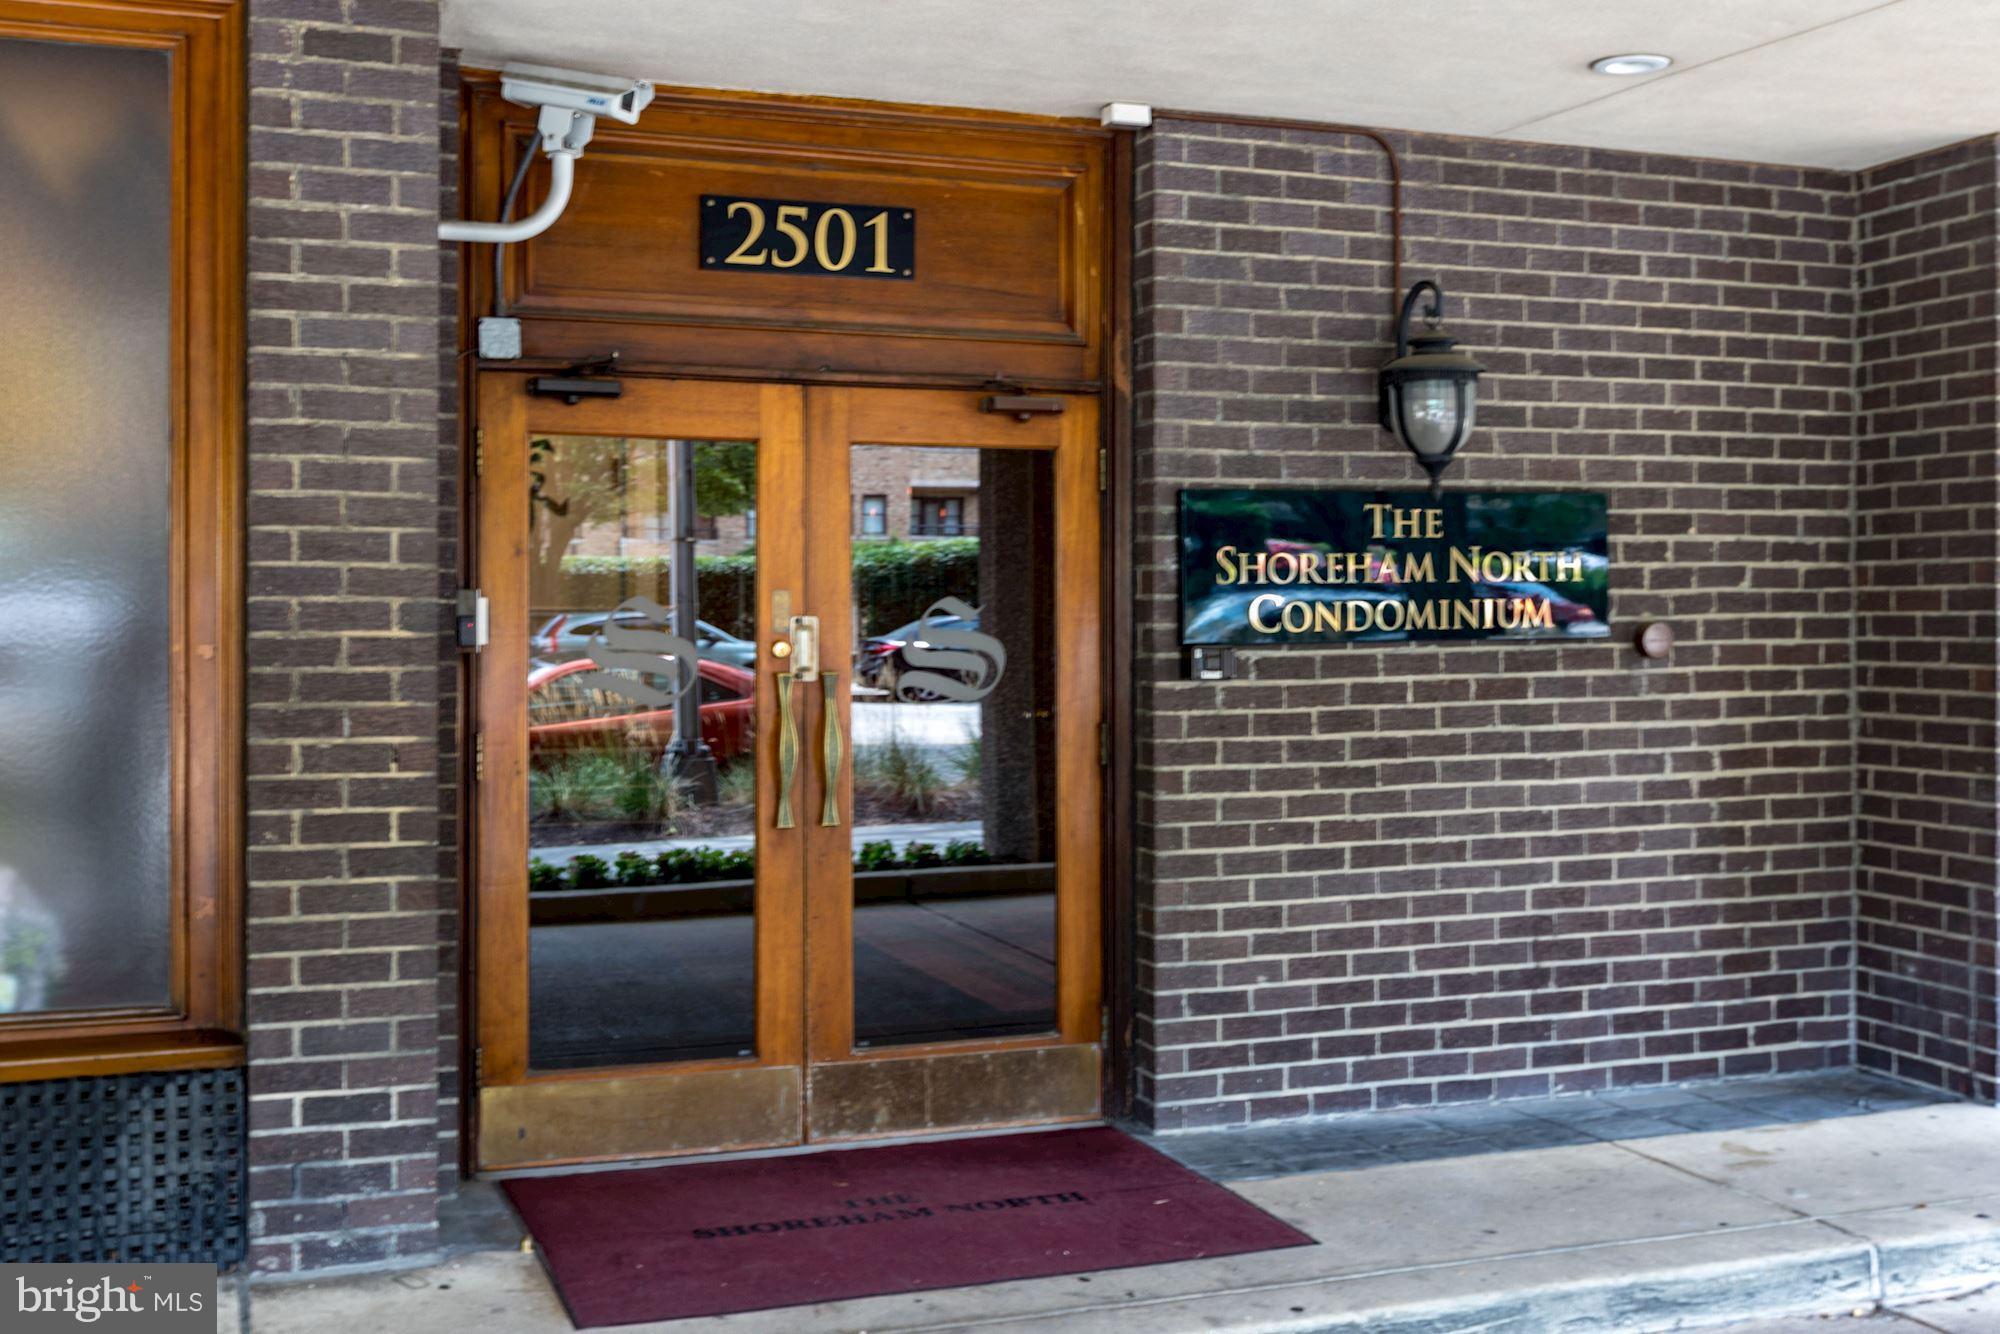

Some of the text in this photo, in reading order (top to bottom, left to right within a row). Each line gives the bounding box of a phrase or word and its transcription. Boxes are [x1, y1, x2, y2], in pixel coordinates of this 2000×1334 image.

[724, 201, 896, 274] 2501
[1362, 503, 1444, 539] THE
[1215, 544, 1585, 586] SHOREHAM NORTH
[1248, 593, 1556, 634] CONDOMINIUM
[692, 1191, 1096, 1239] SHOREHAM NORTH
